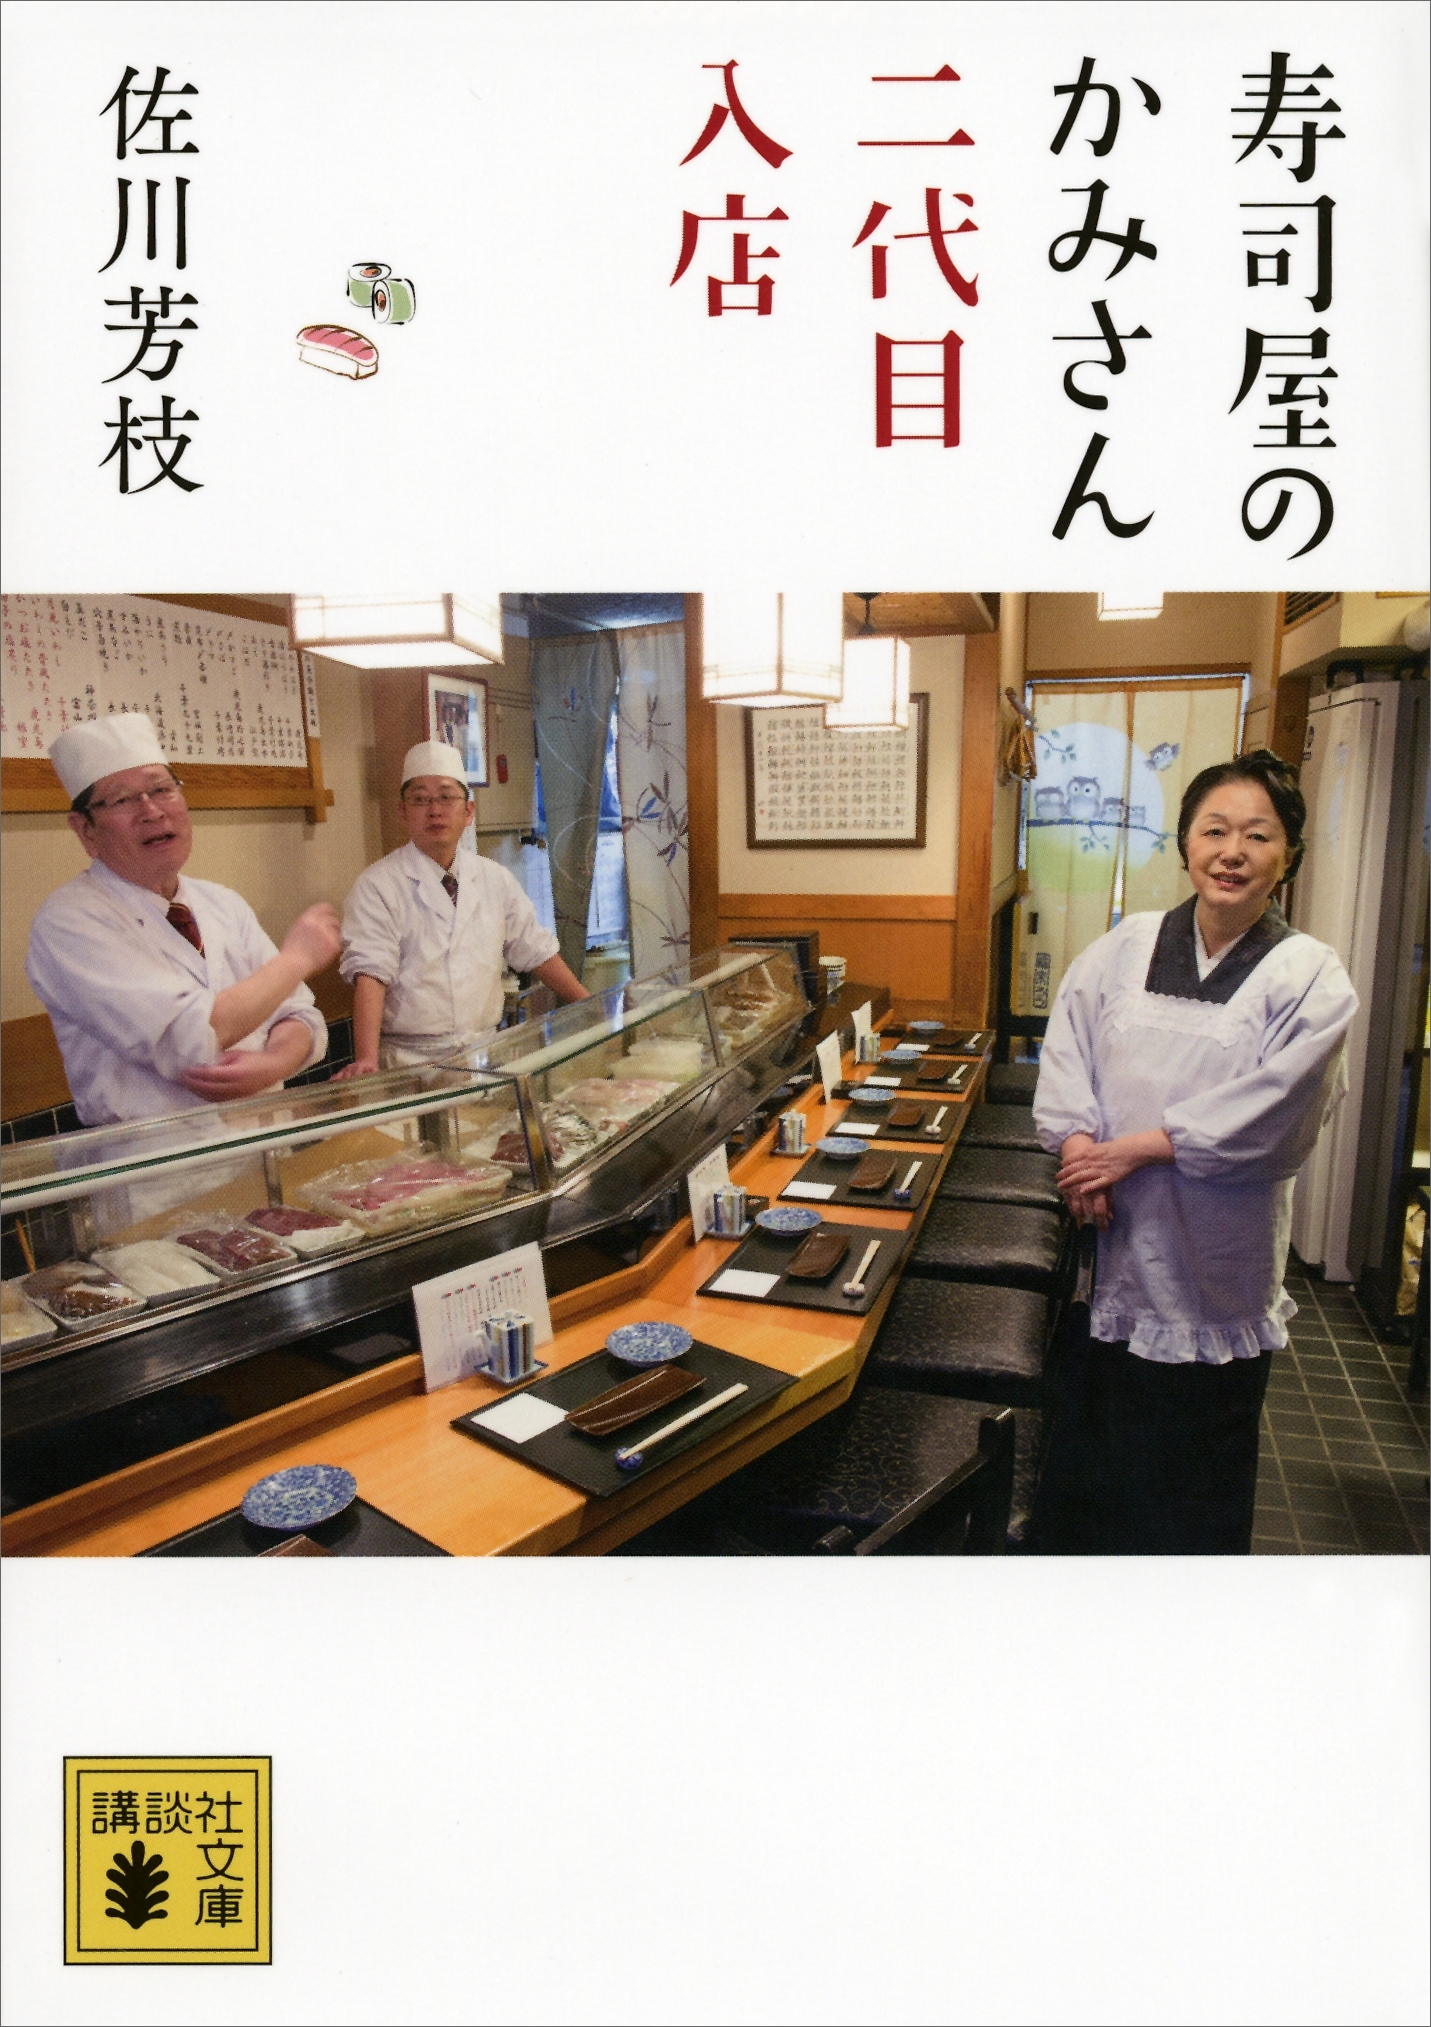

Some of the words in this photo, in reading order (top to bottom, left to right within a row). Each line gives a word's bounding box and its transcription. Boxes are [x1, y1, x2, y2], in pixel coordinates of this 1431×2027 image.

[99, 66, 204, 494] 佐川芳枝
[670, 59, 793, 317] 入店
[853, 64, 978, 448] 二代目
[1049, 56, 1161, 540] かみさん
[1228, 52, 1346, 560] 寿司屋の
[92, 1790, 243, 1834] 講談社
[195, 1838, 244, 1928] 文庫
